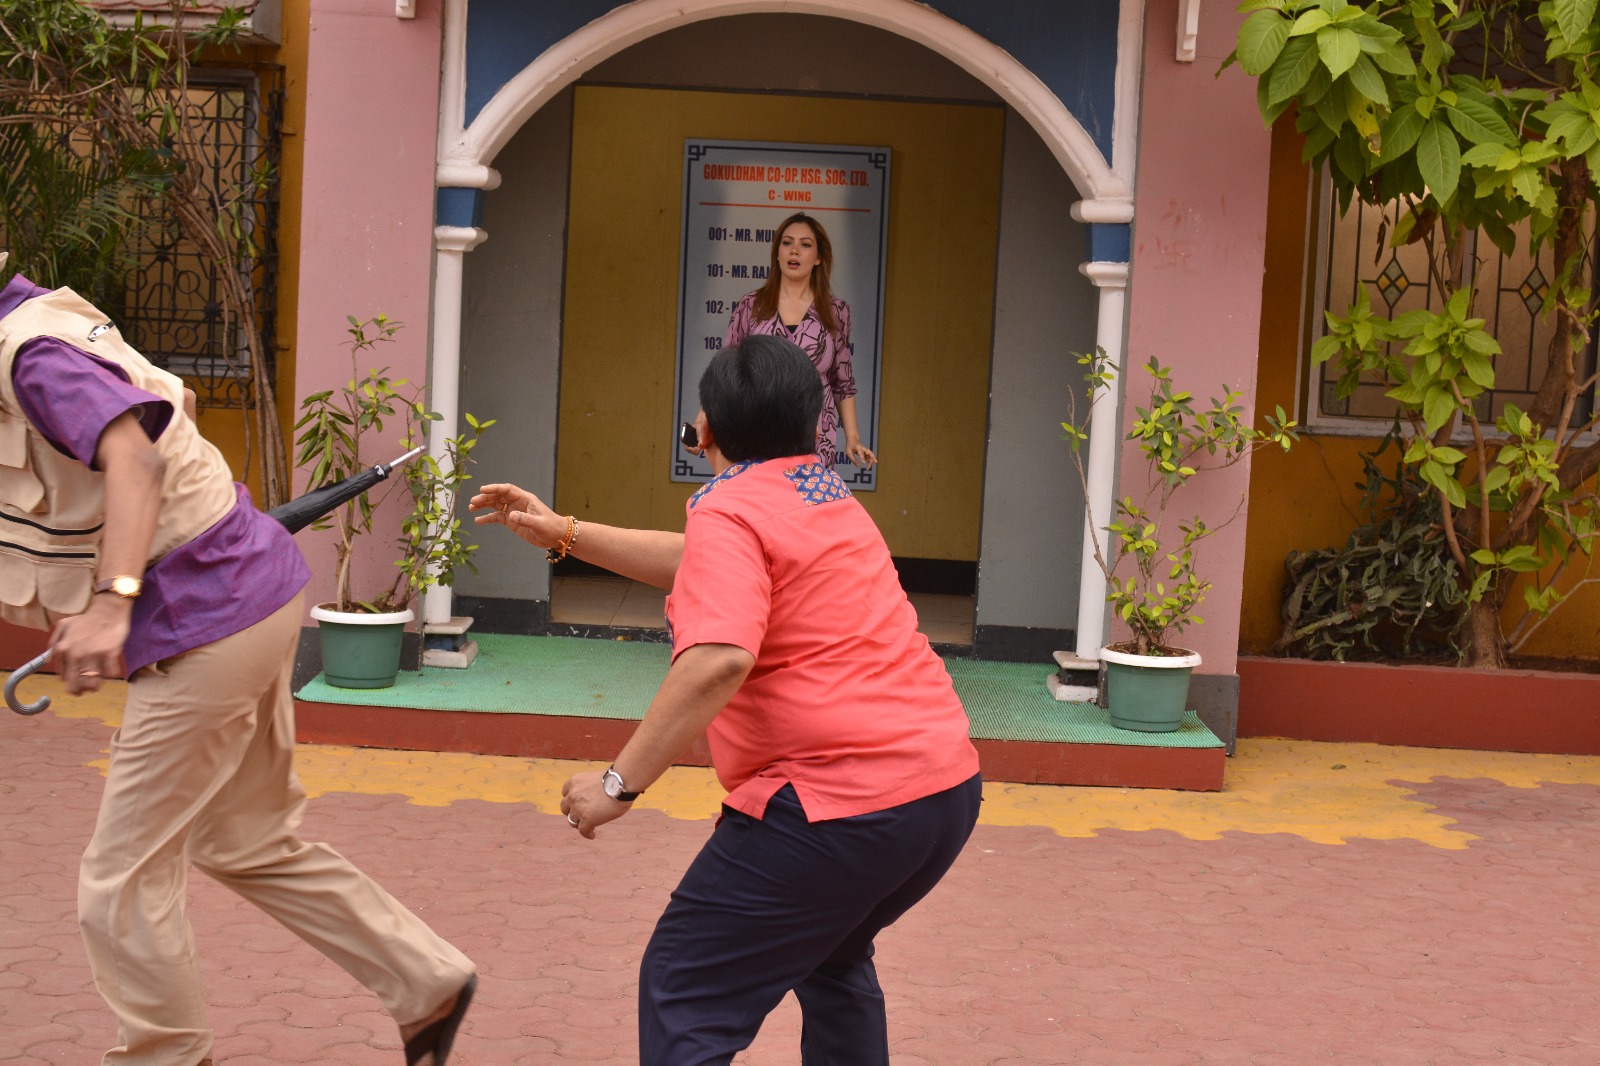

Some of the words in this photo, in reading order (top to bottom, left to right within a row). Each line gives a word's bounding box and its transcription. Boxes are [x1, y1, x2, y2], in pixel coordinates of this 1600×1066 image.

[704, 164, 765, 182] GOKULDHAM
[767, 166, 798, 183] CO-OP.
[801, 168, 823, 184] HSG.
[825, 169, 848, 186] SOC.
[850, 170, 869, 187] LTD.
[768, 189, 776, 200] C
[784, 190, 812, 202] WING
[708, 227, 727, 241] 001
[735, 228, 753, 242] MR.
[707, 264, 724, 277] 101
[732, 265, 750, 278] MR.
[706, 300, 724, 314] 102
[704, 336, 722, 350] 103
